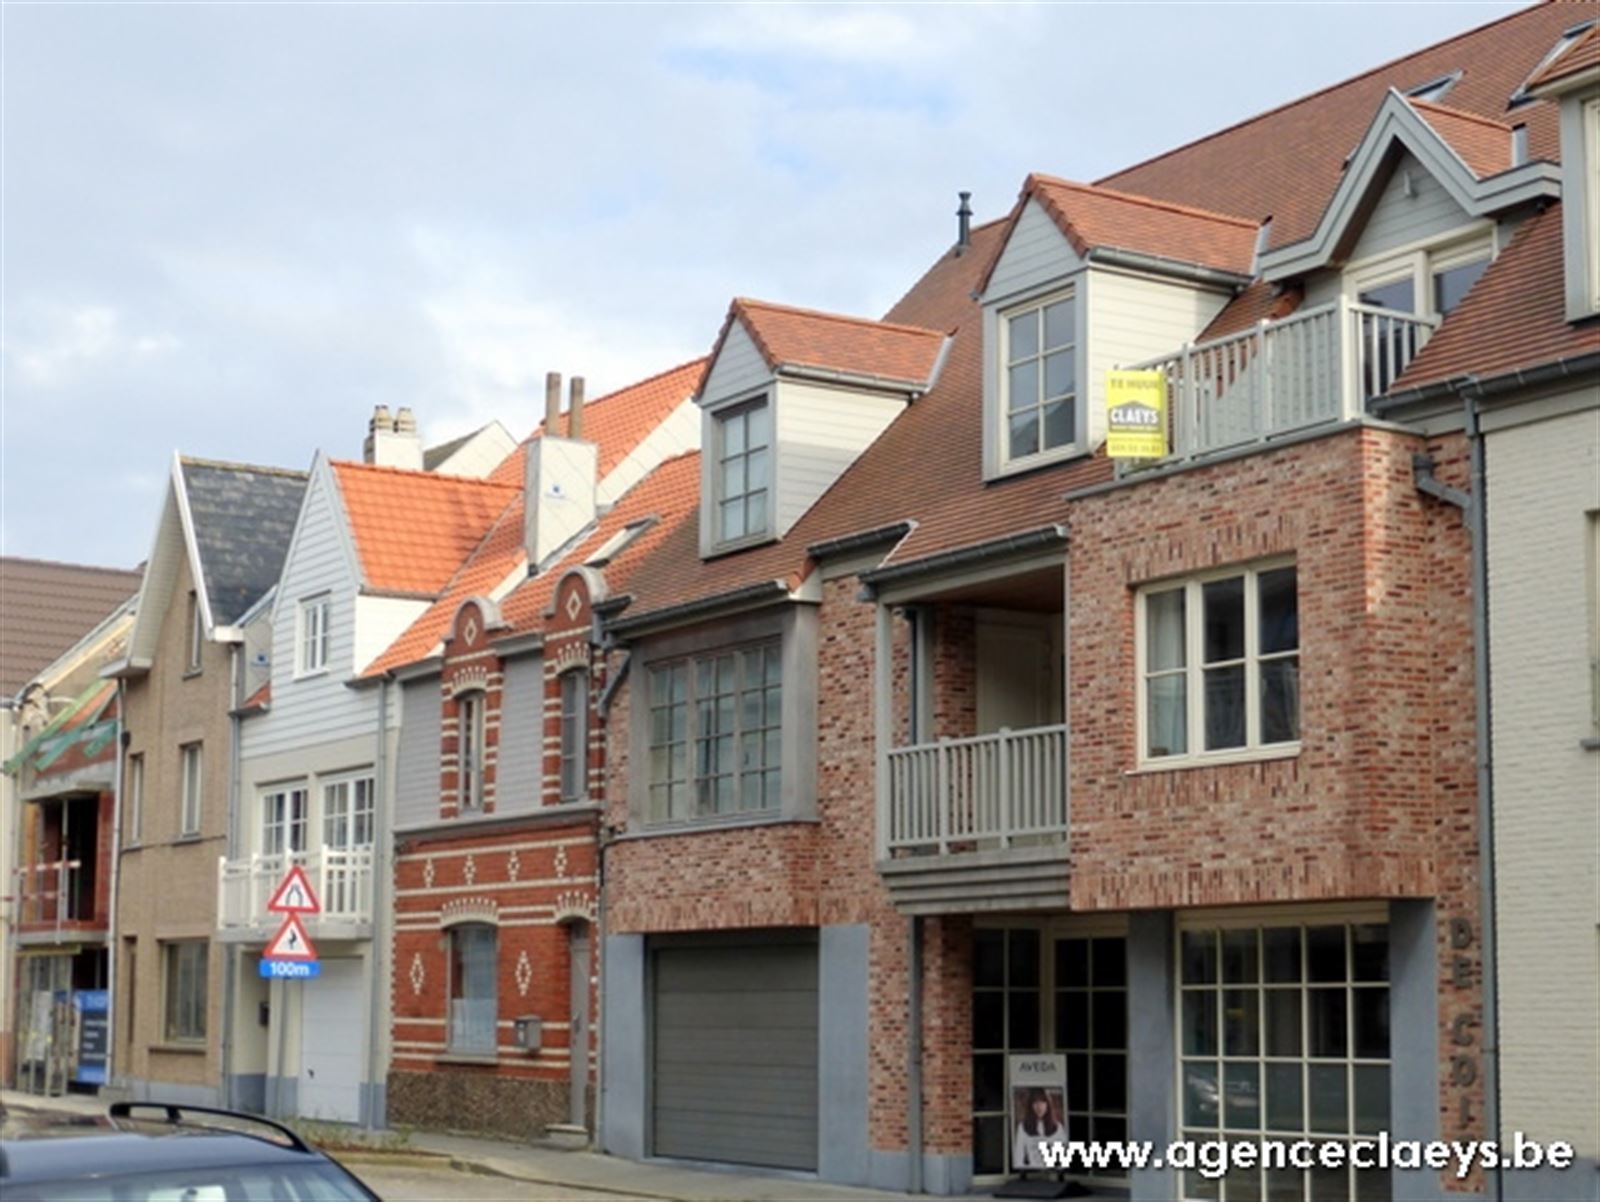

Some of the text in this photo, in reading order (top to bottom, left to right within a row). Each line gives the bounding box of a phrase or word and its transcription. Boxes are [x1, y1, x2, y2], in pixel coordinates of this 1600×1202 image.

[1111, 407, 1158, 424] CLAEYS
[269, 961, 310, 977] 100m
[1019, 1060, 1057, 1073] AVEDA
